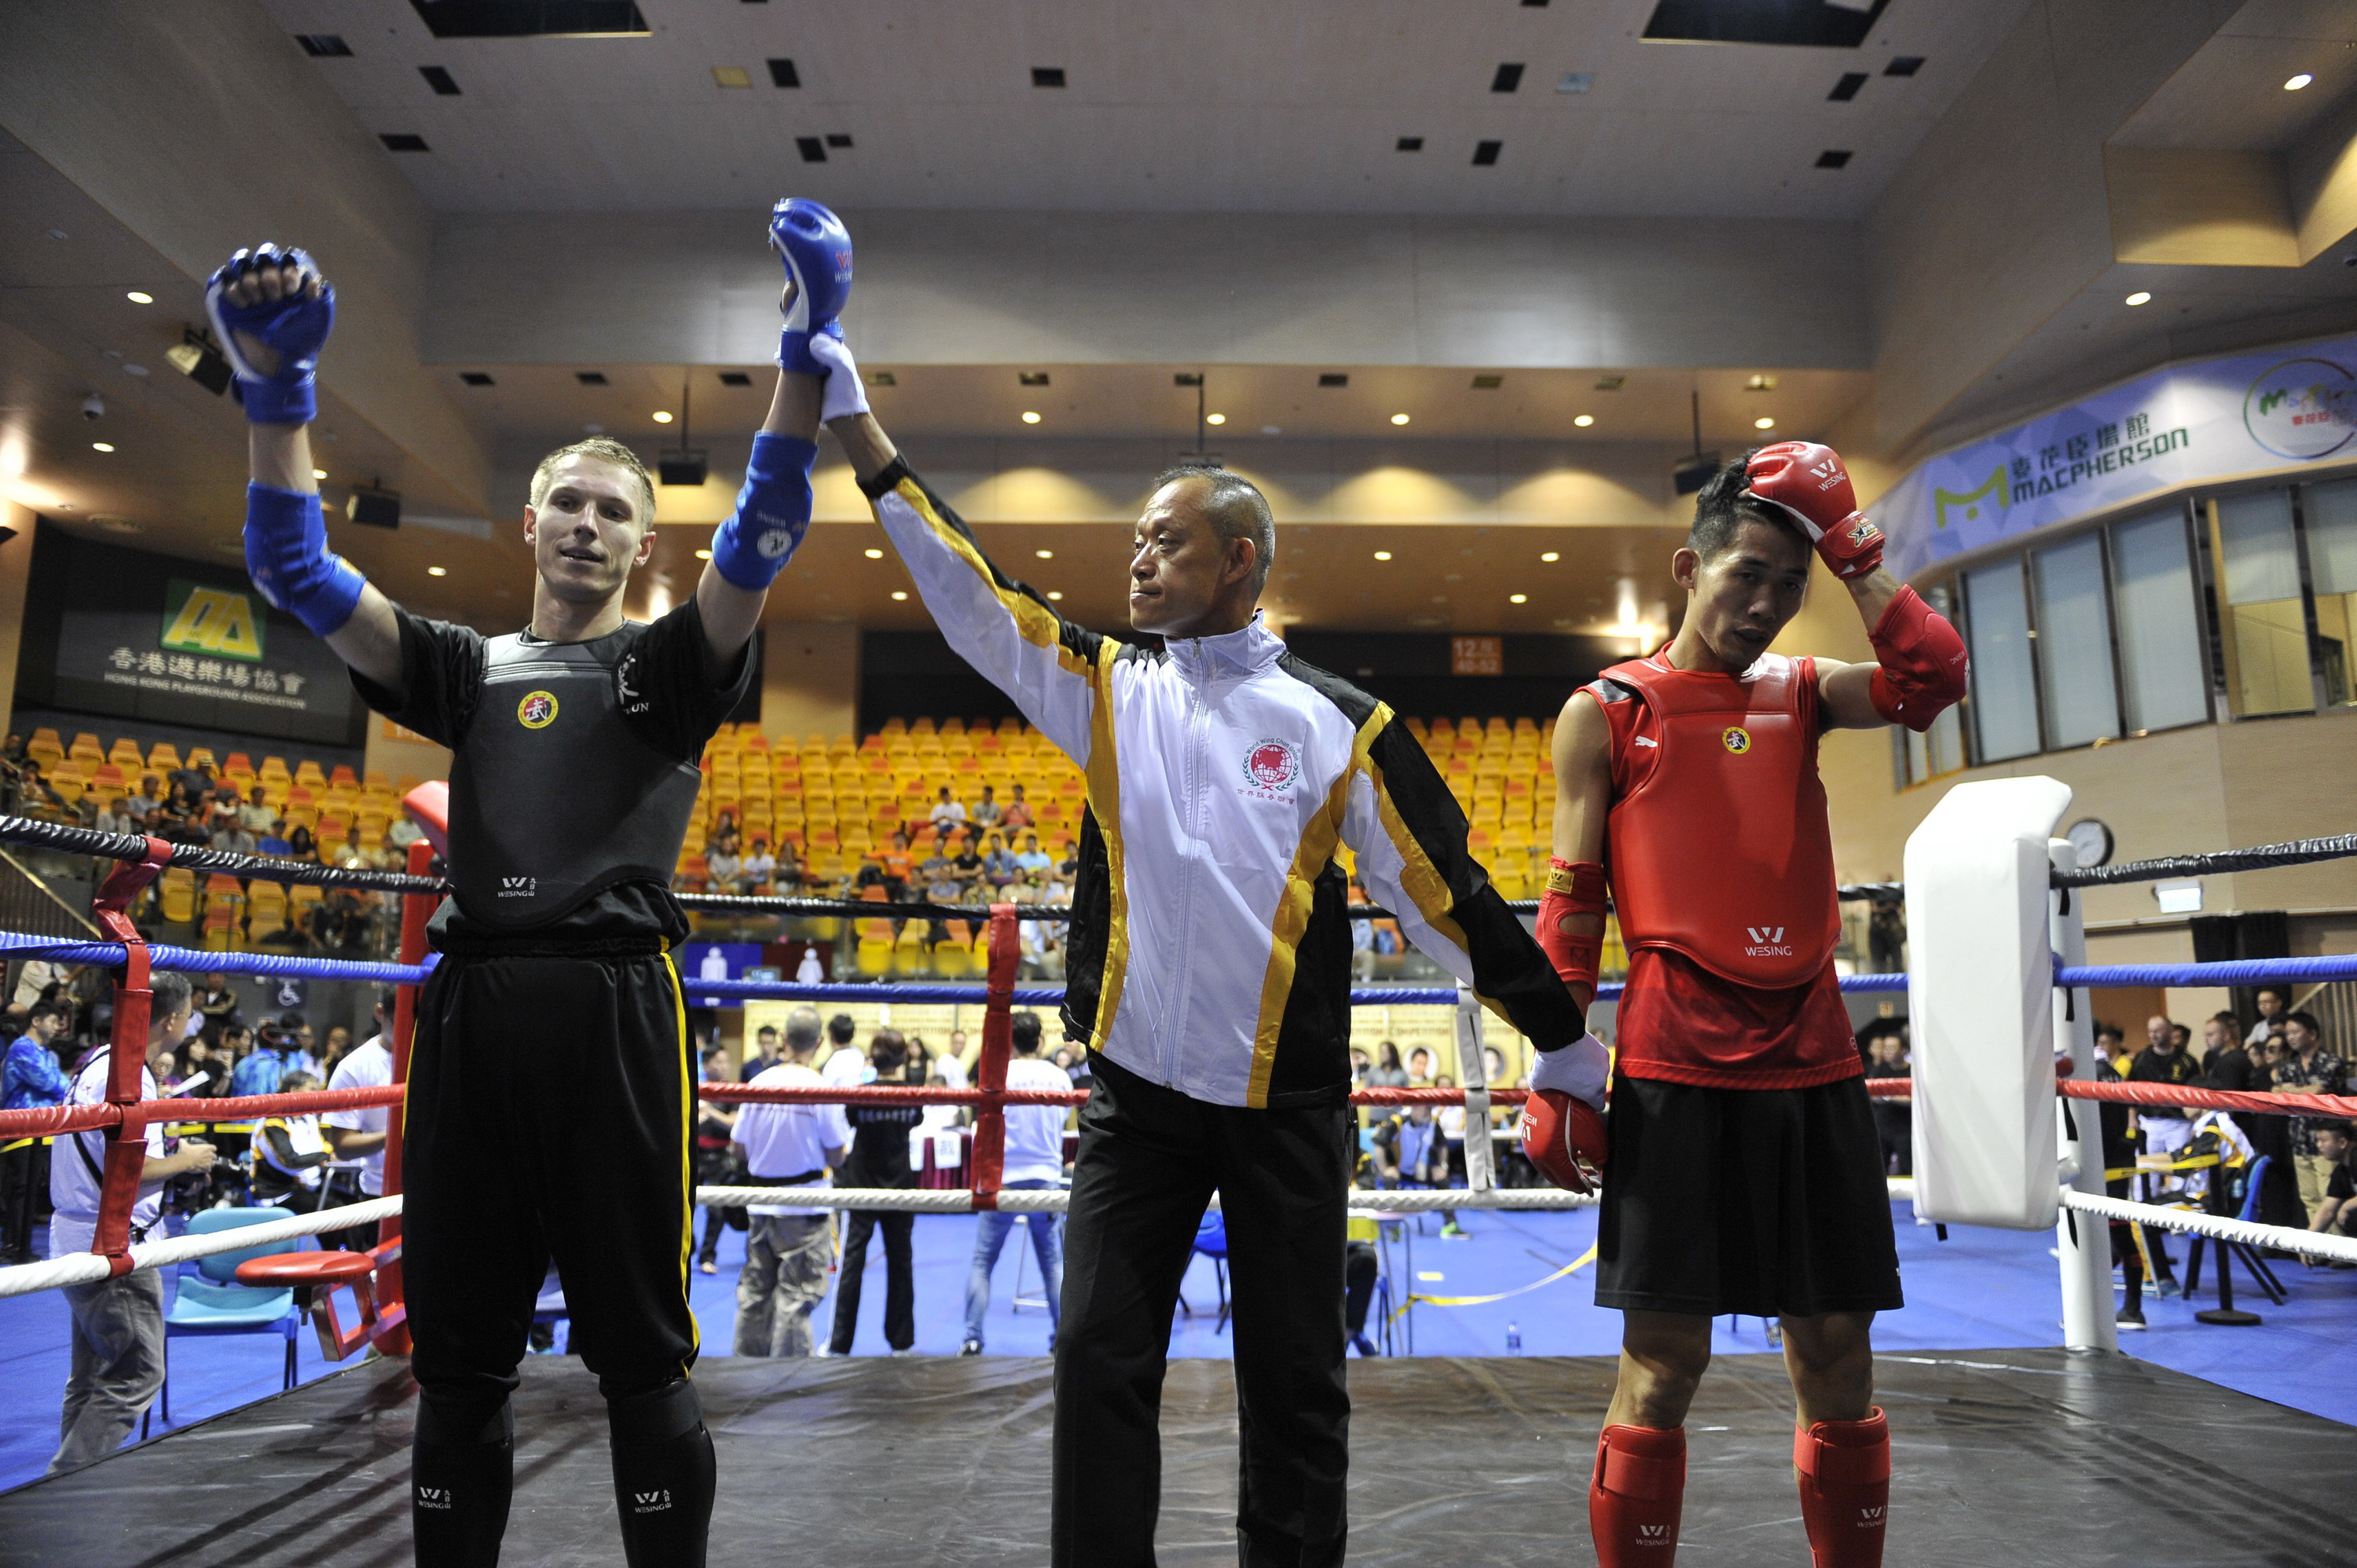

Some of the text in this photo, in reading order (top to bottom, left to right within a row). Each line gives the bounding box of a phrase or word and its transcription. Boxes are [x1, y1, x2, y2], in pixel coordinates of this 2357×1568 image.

[1818, 471, 1846, 491] WESING
[109, 647, 305, 694] 香港遊樂場協會
[104, 672, 305, 709] HONG KONG PLAYGROUND ASSOCIATION
[1246, 742, 1260, 755] World
[1276, 738, 1290, 748] Chun
[1289, 746, 1298, 760] Union
[1745, 945, 1792, 956] WESING
[418, 1499, 445, 1509] WESING
[635, 1504, 665, 1513] WESING
